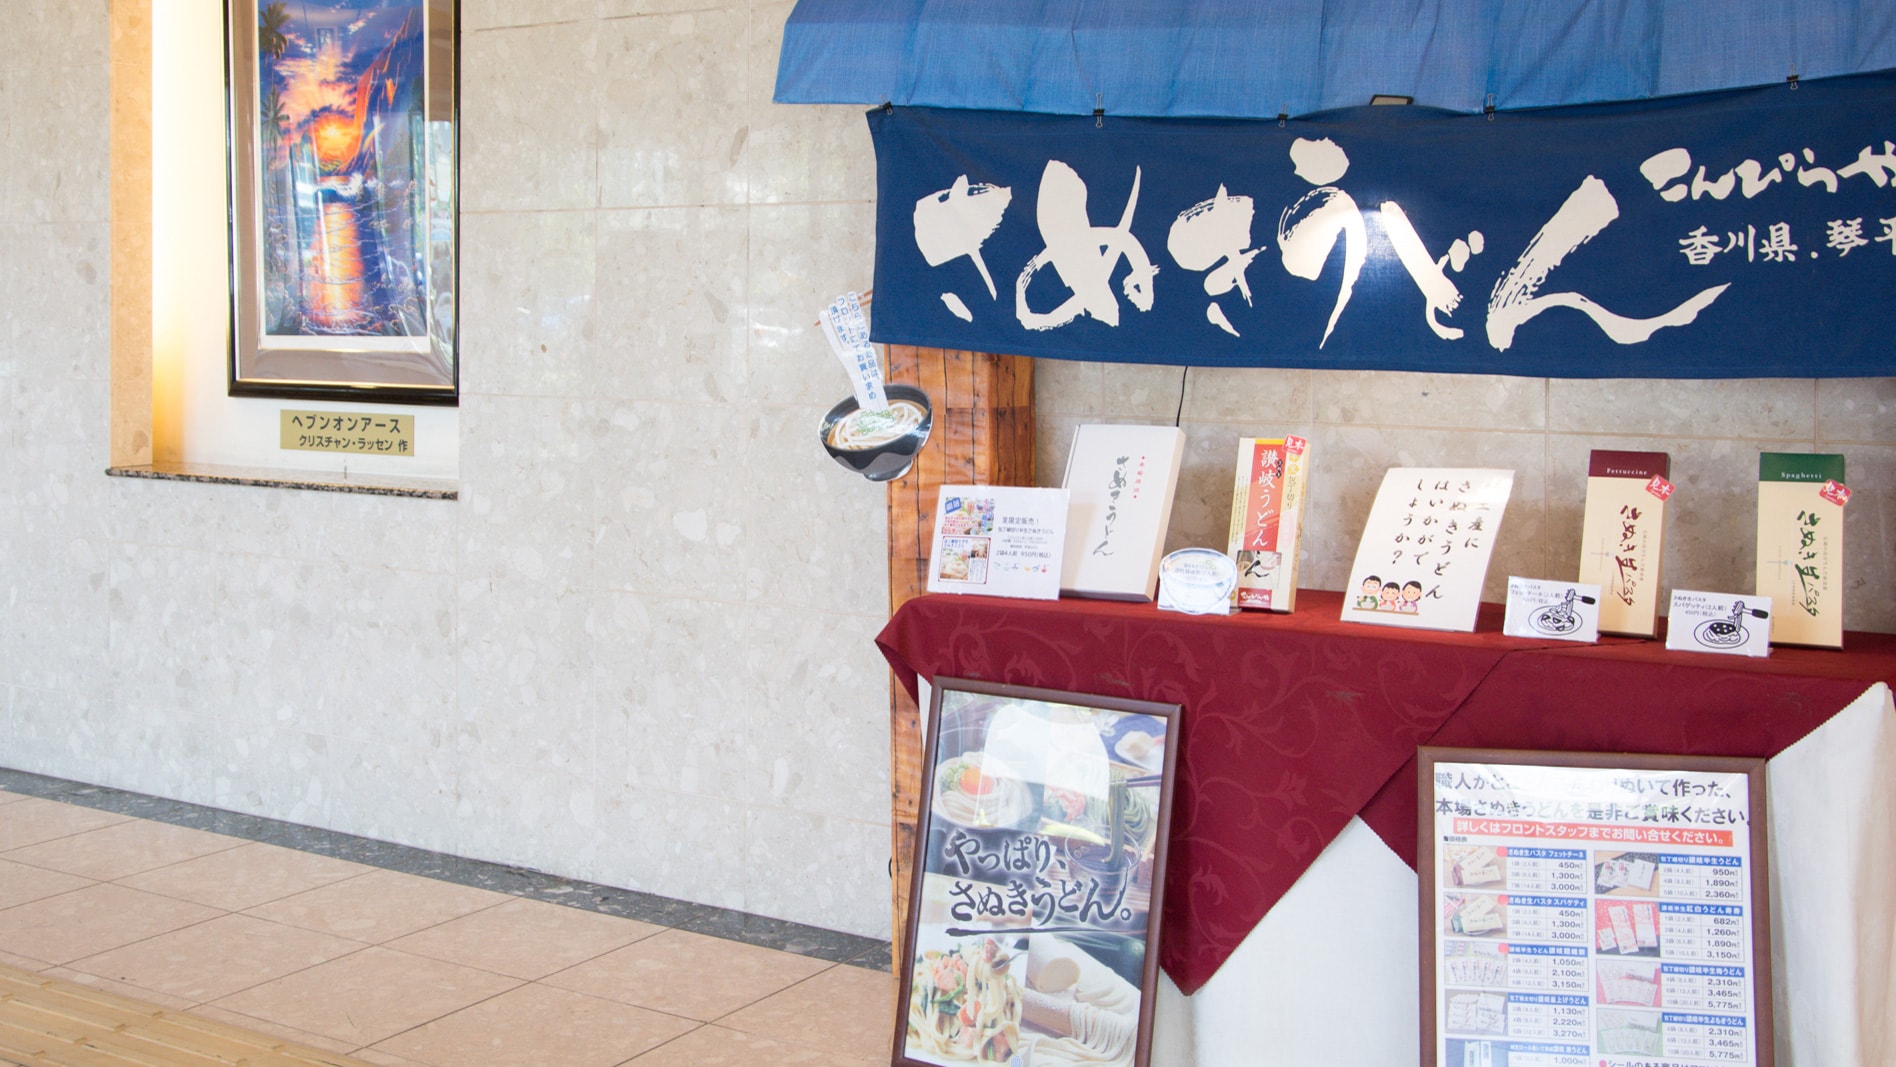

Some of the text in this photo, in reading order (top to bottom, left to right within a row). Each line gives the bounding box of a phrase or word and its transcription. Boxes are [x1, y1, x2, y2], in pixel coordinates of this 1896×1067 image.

[913, 137, 1731, 351] さぬきうどん
[292, 414, 401, 433] ヘブンオンアース
[398, 439, 408, 453] 作
[1606, 467, 1648, 476] Fettuccine
[1781, 471, 1822, 480] Spaghetti
[1251, 449, 1278, 547] 讃岐うどん
[1413, 480, 1448, 566] はいかがで
[1424, 480, 1471, 600] さぬきうどん
[944, 828, 1067, 876] やっぱり、
[949, 870, 1132, 927] さぬきうどん。
